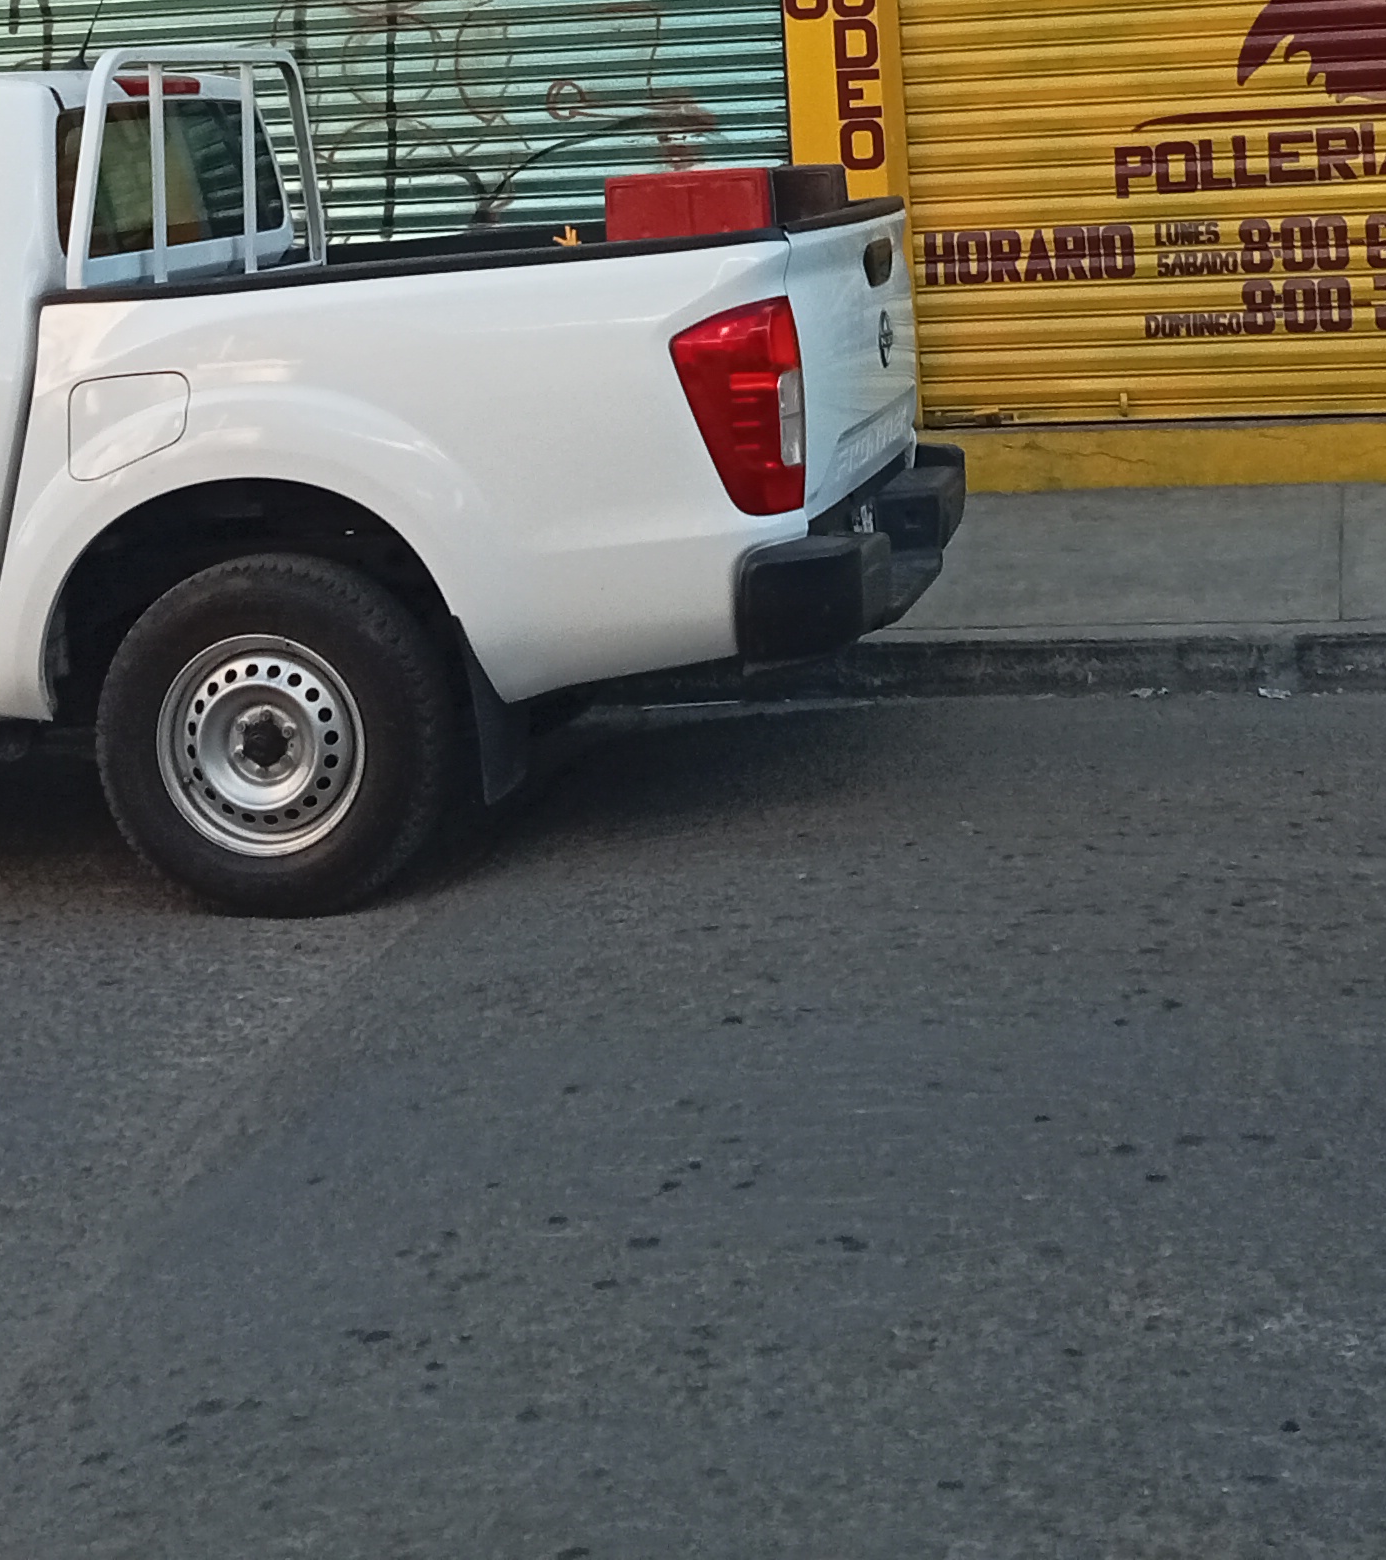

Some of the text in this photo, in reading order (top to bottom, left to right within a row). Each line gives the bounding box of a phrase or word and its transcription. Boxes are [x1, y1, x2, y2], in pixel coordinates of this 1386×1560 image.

[1155, 221, 1220, 246] LUNES
[924, 225, 1136, 286] HORARIO
[1157, 251, 1238, 277] SABADO
[1145, 313, 1242, 338] DOMINGO
